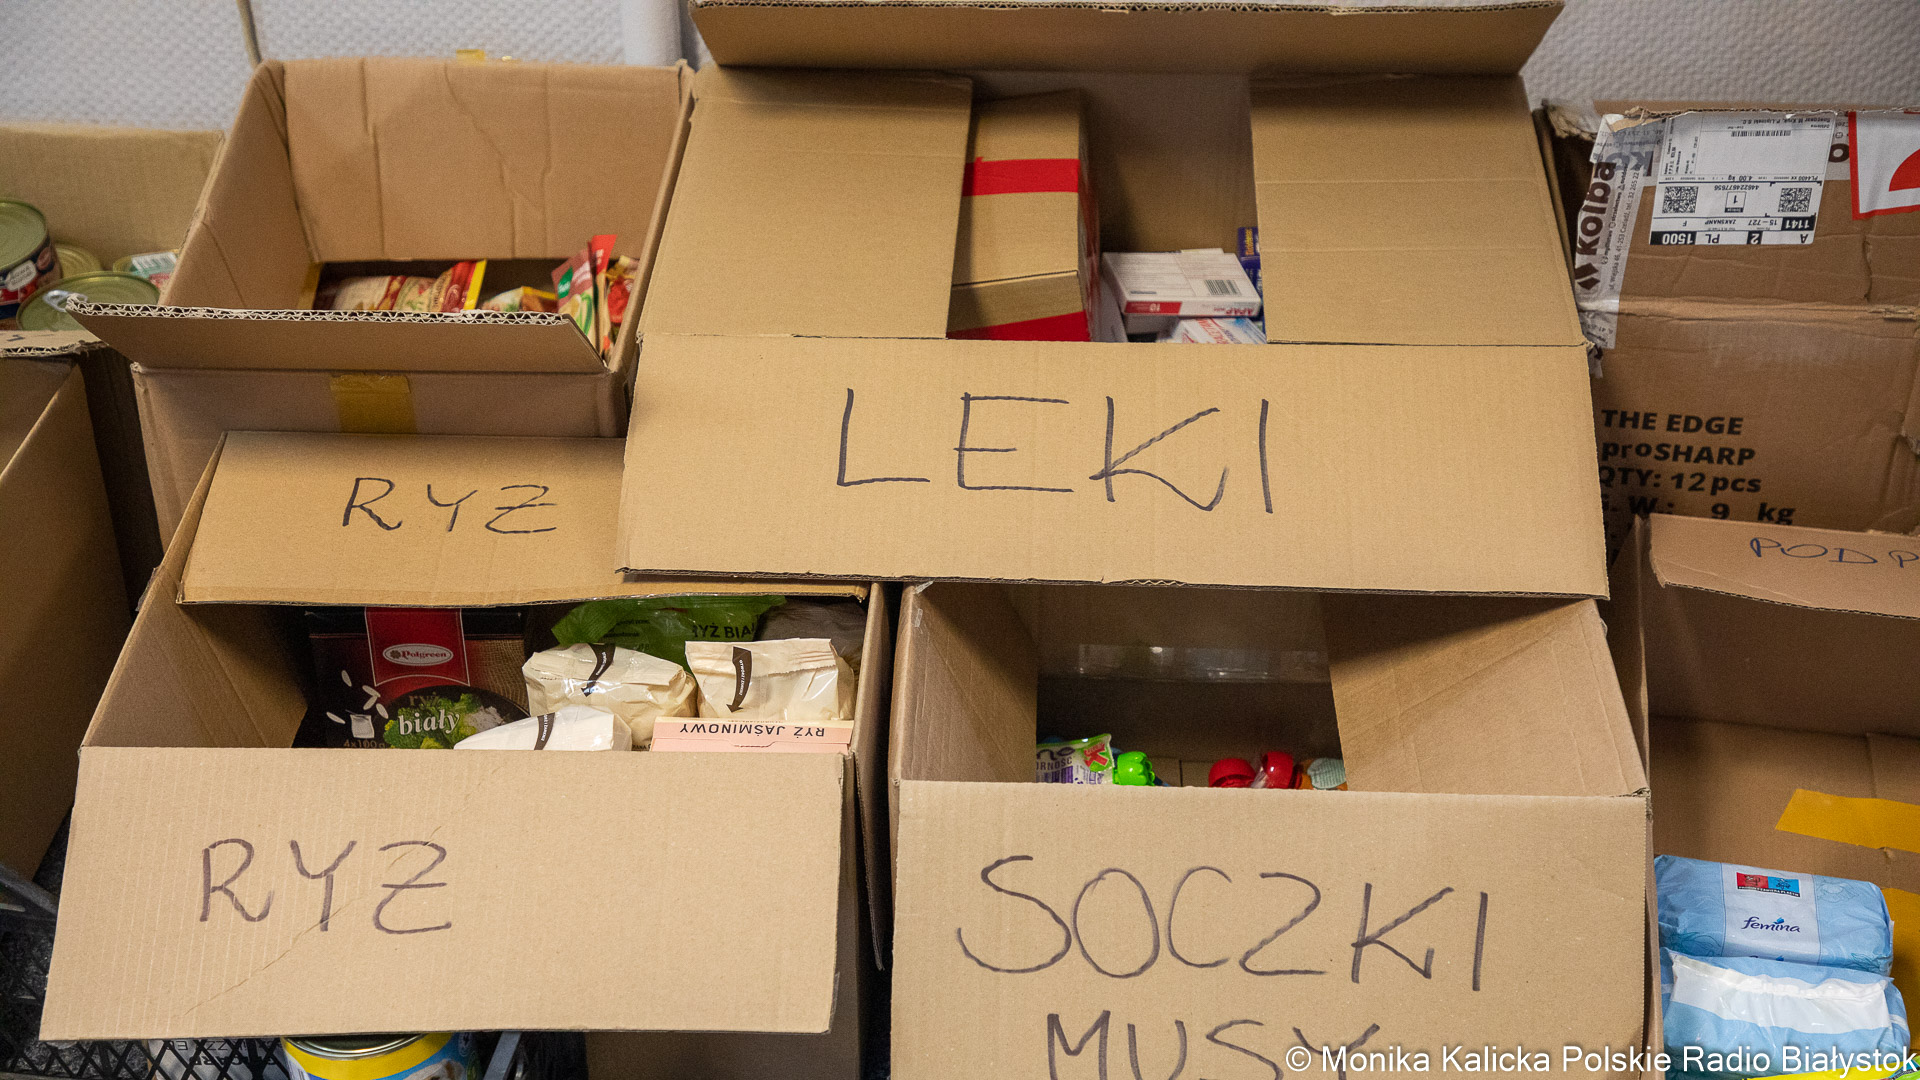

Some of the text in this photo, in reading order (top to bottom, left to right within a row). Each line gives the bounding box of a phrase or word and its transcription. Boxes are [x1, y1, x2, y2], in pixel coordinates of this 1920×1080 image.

[1785, 219, 1810, 228] 1141
[1662, 233, 1693, 245] 1500
[1705, 233, 1720, 244] PL
[1750, 232, 1760, 244] 2
[1800, 233, 1809, 244] A
[1601, 410, 1744, 435] THE EDGE
[837, 388, 1273, 514] LEKI
[1602, 442, 1756, 466] proSHARP
[1599, 465, 1661, 488] QTY:
[1711, 503, 1730, 520] 9
[1757, 502, 1795, 526] kg
[724, 623, 755, 639] BIA
[401, 650, 447, 660] Polgreen
[398, 709, 460, 736] biały
[680, 723, 825, 739] RYŻ JAŚMINOWY
[957, 855, 1489, 992] SOCZKI
[1741, 916, 1801, 933] femina
